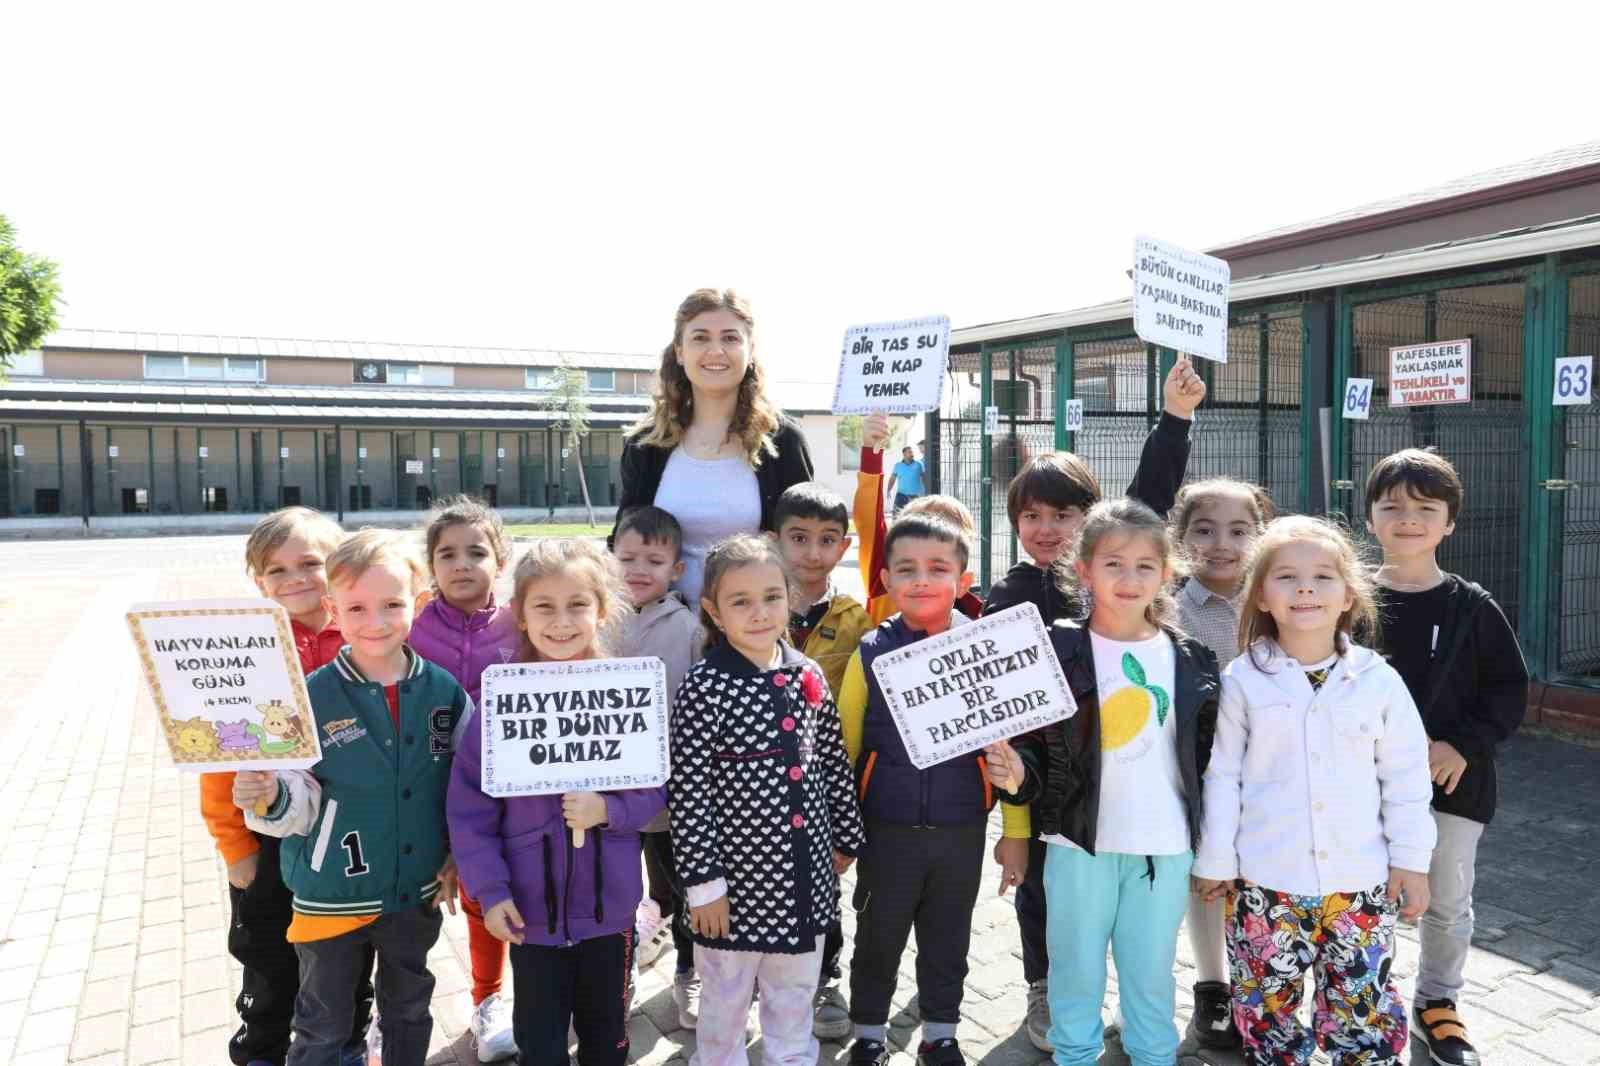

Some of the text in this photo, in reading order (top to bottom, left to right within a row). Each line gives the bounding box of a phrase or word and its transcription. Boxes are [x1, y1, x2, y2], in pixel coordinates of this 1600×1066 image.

[1140, 255, 1224, 296] BÜTÜN CANLILAR
[851, 334, 938, 355] BİR TAS SU
[1396, 345, 1462, 361] KAFESLERE
[862, 355, 923, 375] BİR KAP
[1395, 358, 1463, 373] YAKLAŞMAK
[864, 382, 911, 397] YEMEK
[1558, 364, 1588, 397] 63
[1346, 384, 1369, 412] 64
[1067, 404, 1081, 426] 66
[154, 636, 276, 653] HAYVANLARI
[175, 656, 256, 672] KORUMA
[928, 639, 1000, 676] ONLAR
[192, 673, 246, 690] GÜNÜ
[901, 645, 1040, 708] HAYATIMIZIN
[496, 687, 652, 715] HAYVANSIZ
[557, 712, 649, 738] DÜNYA
[529, 739, 622, 766] OLMAZ
[341, 831, 370, 877] 1
